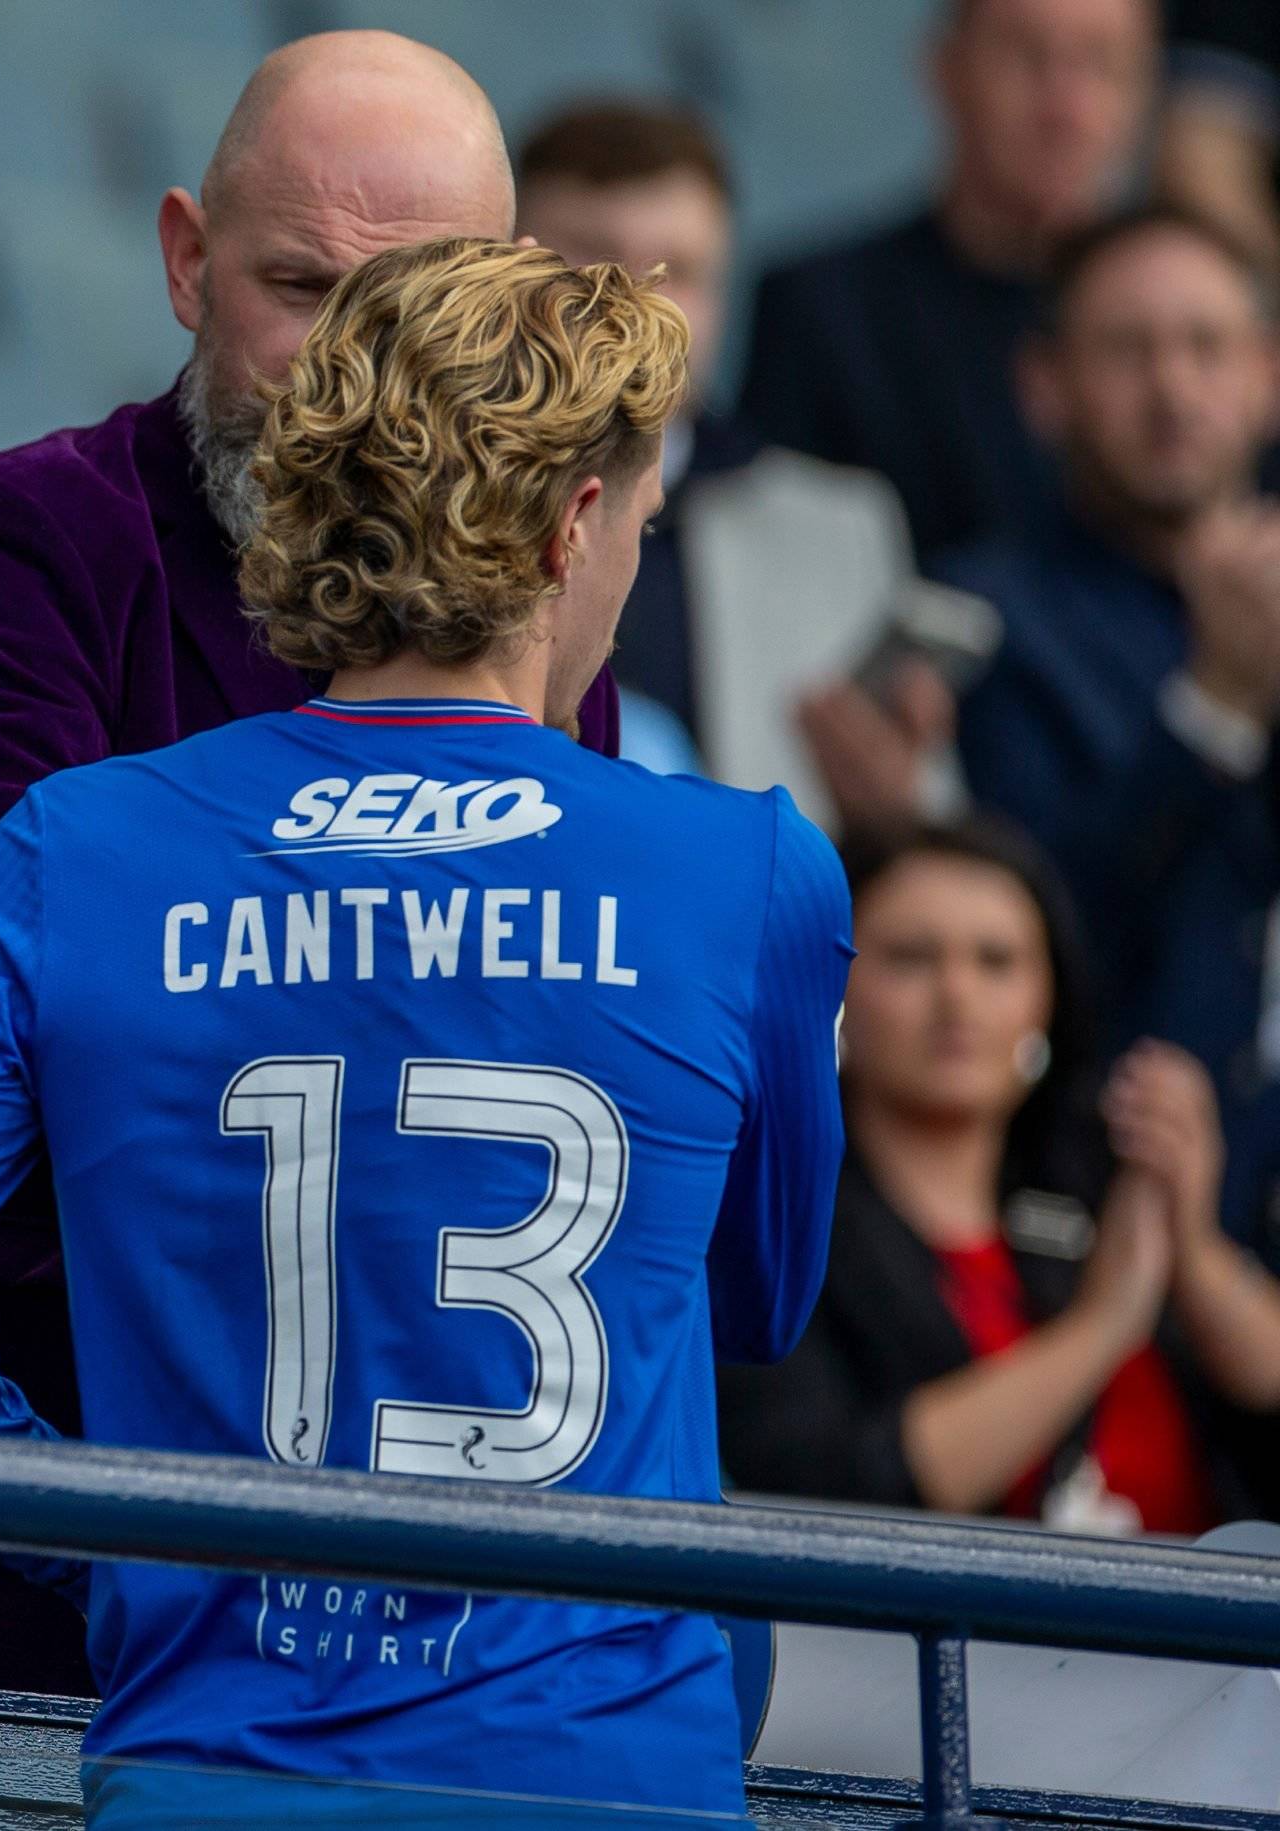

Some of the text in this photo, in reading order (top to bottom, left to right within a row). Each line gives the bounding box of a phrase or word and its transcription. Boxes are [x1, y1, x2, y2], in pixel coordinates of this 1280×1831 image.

[272, 774, 562, 839] SEKO
[164, 888, 637, 993] CANTWELL
[220, 1055, 629, 1489] 13
[280, 1582, 406, 1621] WORN
[277, 1627, 436, 1664] SHIRT
